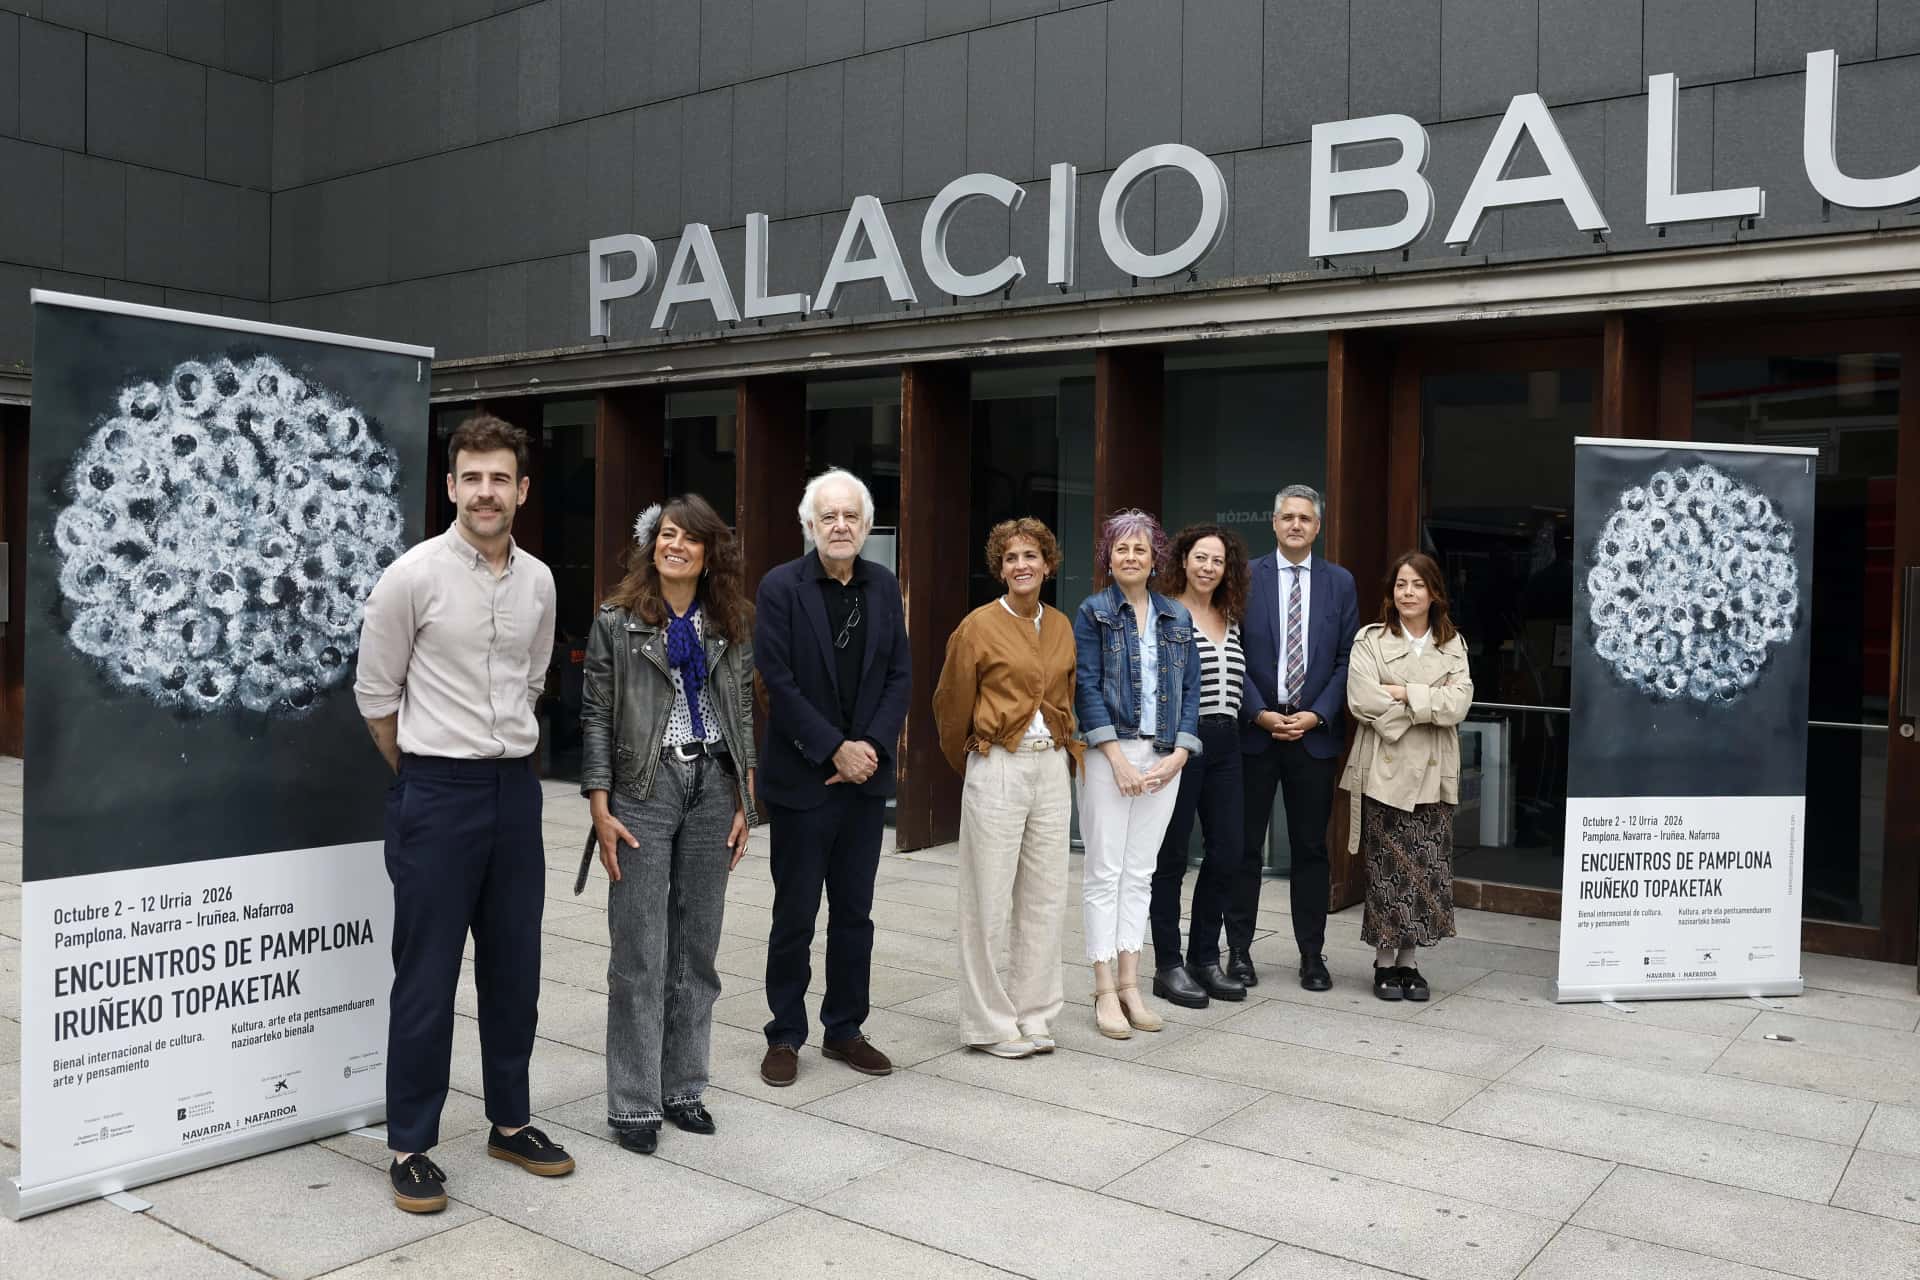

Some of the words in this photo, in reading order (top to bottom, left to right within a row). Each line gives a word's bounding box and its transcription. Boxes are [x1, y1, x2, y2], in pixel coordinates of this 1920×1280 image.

[589, 143, 1229, 337] PALACIO
[1582, 816, 1612, 827] Octubre
[1615, 816, 1620, 827] 2
[1629, 815, 1637, 826] 12
[1639, 815, 1658, 826] Urria
[1664, 815, 1683, 826] 2026
[1623, 830, 1652, 841] Navarra
[1689, 829, 1720, 840] Nafarroa
[1581, 851, 1671, 872] ENCUENTROS
[1676, 851, 1694, 871] DE
[1699, 851, 1772, 870] PAMPLONA
[1580, 876, 1639, 900] IRUÑEKO
[1644, 878, 1723, 898] TOPAKETAK
[54, 904, 110, 925] Octubre
[115, 900, 122, 917] 2
[141, 895, 155, 913] 12
[160, 891, 192, 910] Urria
[202, 885, 233, 904] 2026
[1578, 909, 1596, 918] Bienal
[1633, 908, 1639, 916] de
[55, 927, 126, 949] Pamplona,
[131, 919, 182, 937] Navarra
[197, 909, 239, 927] Iruñea,
[243, 902, 294, 920] Nafarroa
[1577, 920, 1590, 928] arte
[55, 944, 216, 997] ENCUENTROS
[225, 937, 252, 968] DE
[261, 918, 374, 962] PAMPLONA
[55, 994, 163, 1042] IRUÑEKO
[171, 969, 301, 1018] TOPAKETAK
[231, 1021, 265, 1035] Kultura,
[268, 1015, 286, 1027] arte
[288, 1011, 301, 1023] eta
[303, 998, 375, 1022] pentsamenduaren
[231, 1030, 282, 1049] nazioarteko
[284, 1023, 315, 1039] bienala
[53, 1054, 85, 1072] Bienal
[88, 1040, 152, 1065] internacional
[155, 1038, 167, 1051] de
[53, 1074, 74, 1088] arte
[77, 1073, 83, 1086] y
[86, 1059, 150, 1084] pensamiento
[182, 1121, 231, 1141] NAVARRA
[244, 1104, 297, 1125] NAFARROA
